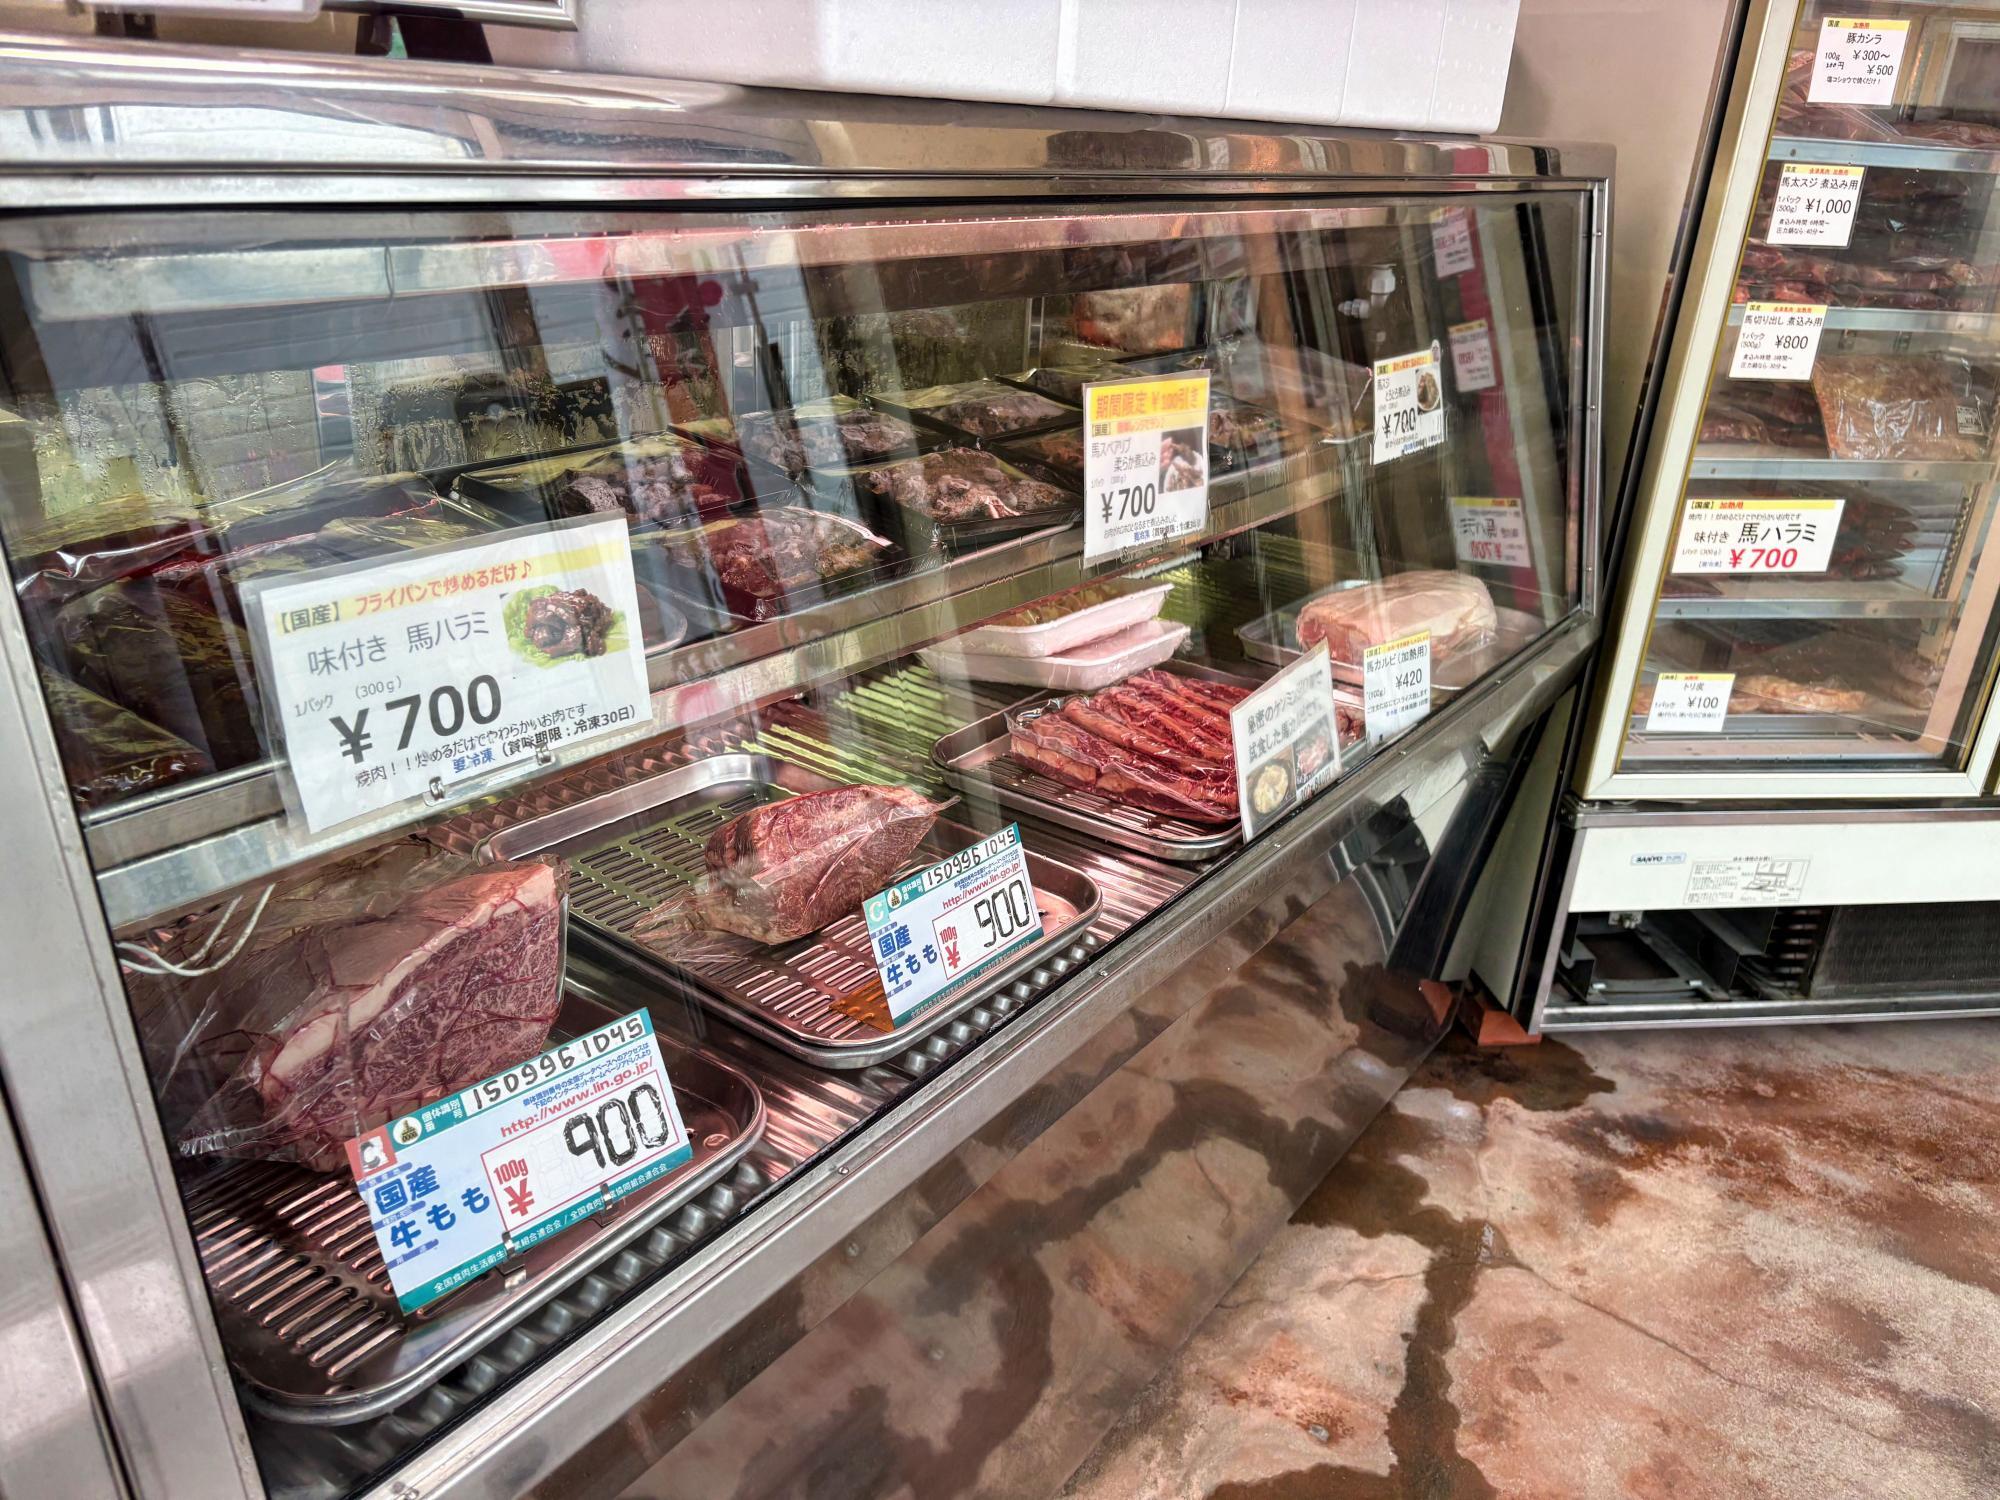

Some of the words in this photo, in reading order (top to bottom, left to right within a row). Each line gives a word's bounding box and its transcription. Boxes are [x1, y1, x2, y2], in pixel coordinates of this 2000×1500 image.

[1846, 32, 1882, 44] 豚カシラ
[1825, 51, 1840, 61] 100g
[1867, 64, 1894, 76] ¥500
[1781, 176, 1818, 189] 馬太スジ
[1820, 179, 1859, 191] 煮込み用
[1805, 198, 1852, 215] ¥1,000
[1744, 315, 1784, 326] 馬切り出し
[1786, 316, 1823, 328] 煮込み用
[1775, 334, 1809, 350] ¥800
[1097, 391, 1148, 419] 期間限定
[1383, 407, 1416, 439] ¥700
[1092, 436, 1132, 458] 馬スペアリブ
[1101, 482, 1156, 524] ¥700
[1719, 501, 1744, 510] 加熱用
[1693, 530, 1730, 544] 味付き
[1737, 522, 1817, 545] 馬ハラミ
[1728, 548, 1798, 569] ¥700
[280, 601, 341, 634] 【国産】
[307, 634, 387, 676] 味付き
[406, 611, 489, 654] 馬ハラミ
[1395, 668, 1423, 690] ¥420
[294, 694, 334, 718] 1パック
[1688, 696, 1719, 710] ¥100
[329, 674, 502, 765] ¥700
[940, 926, 958, 945] 100g
[974, 880, 1030, 948] 900
[878, 924, 912, 959] 国産
[945, 940, 961, 969] ¥
[887, 944, 938, 985] 牛もも
[500, 1055, 653, 1138] http://www.lin.go.jp/
[493, 1157, 529, 1185] 100g
[562, 1082, 669, 1169] 900
[374, 1164, 441, 1216] 国産
[503, 1177, 535, 1217] ¥
[390, 1186, 491, 1249] 牛もも
